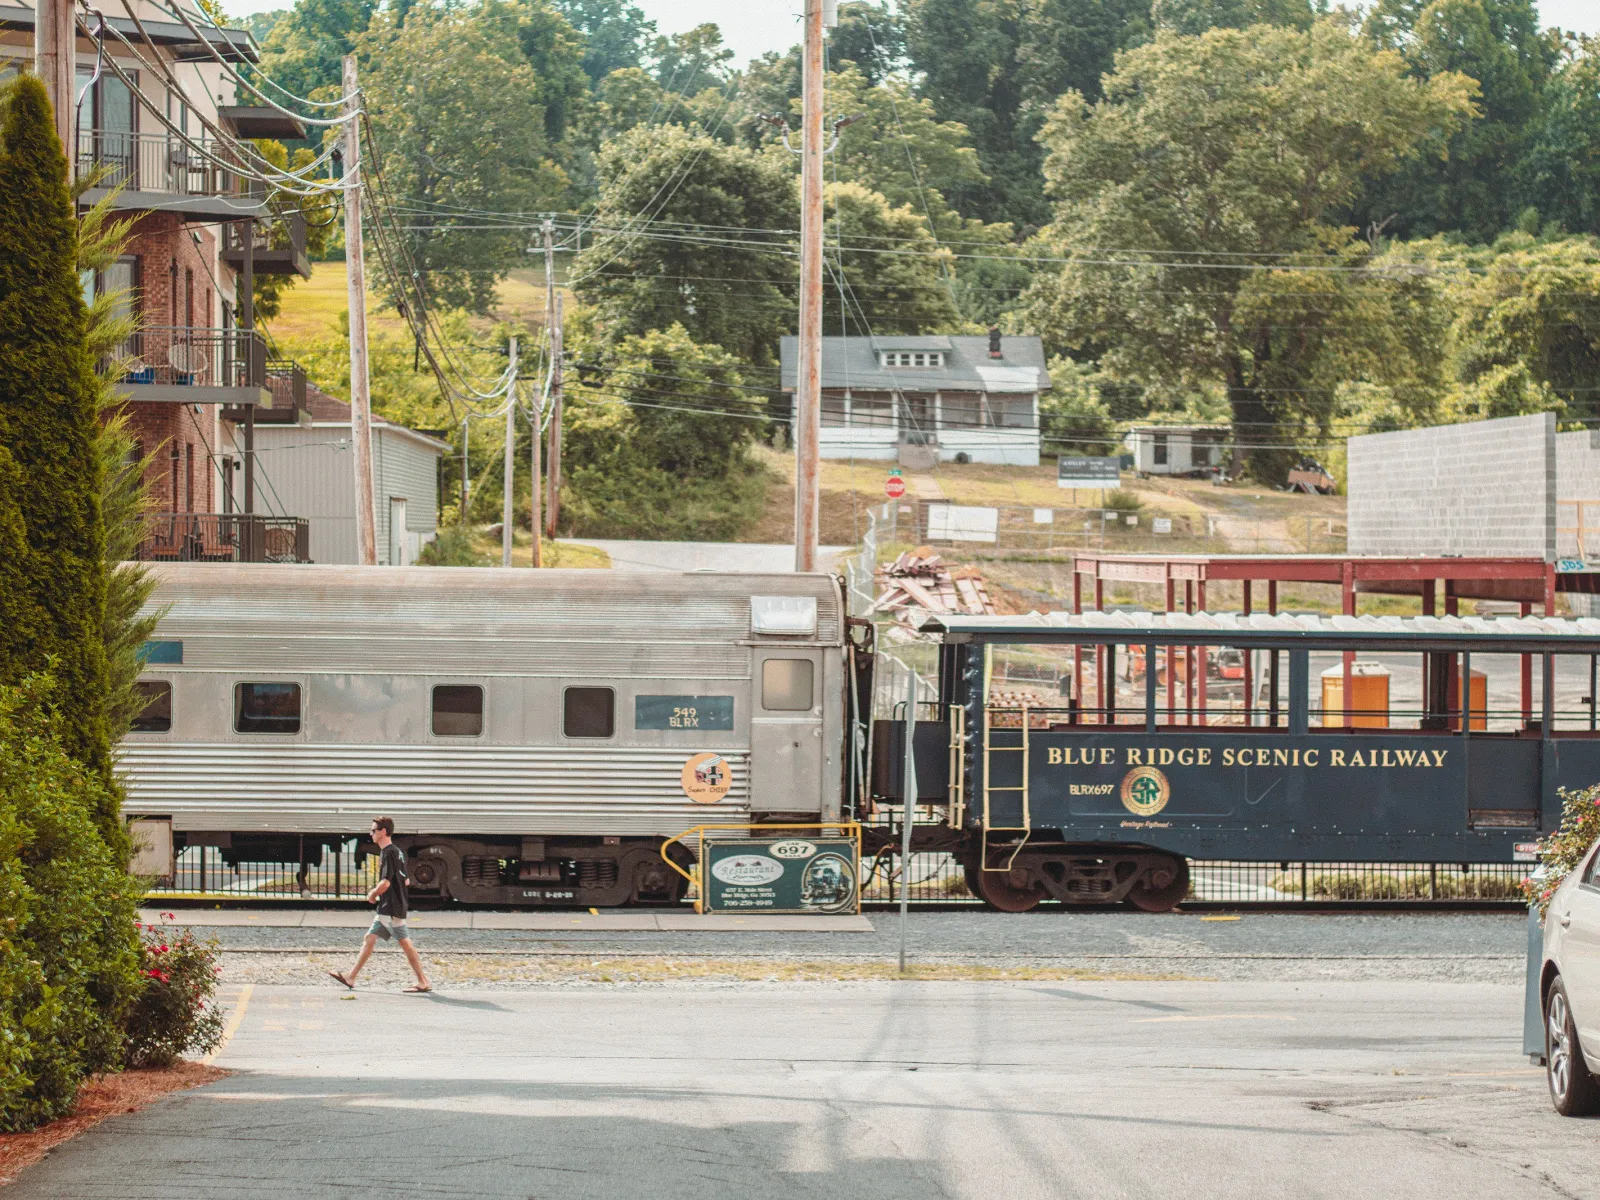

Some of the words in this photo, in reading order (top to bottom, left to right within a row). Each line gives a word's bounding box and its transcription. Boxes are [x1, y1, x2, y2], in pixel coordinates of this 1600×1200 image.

[673, 707, 697, 718] 549
[669, 717, 699, 727] BLRX
[1047, 747, 1115, 765] BLUE
[1126, 748, 1212, 766] RIDGE
[1222, 748, 1320, 767] SCENIC
[1330, 749, 1448, 767] RAILWAY
[1069, 784, 1115, 796] BLRX697
[778, 846, 809, 855] 697
[721, 866, 775, 877] Restaurant
